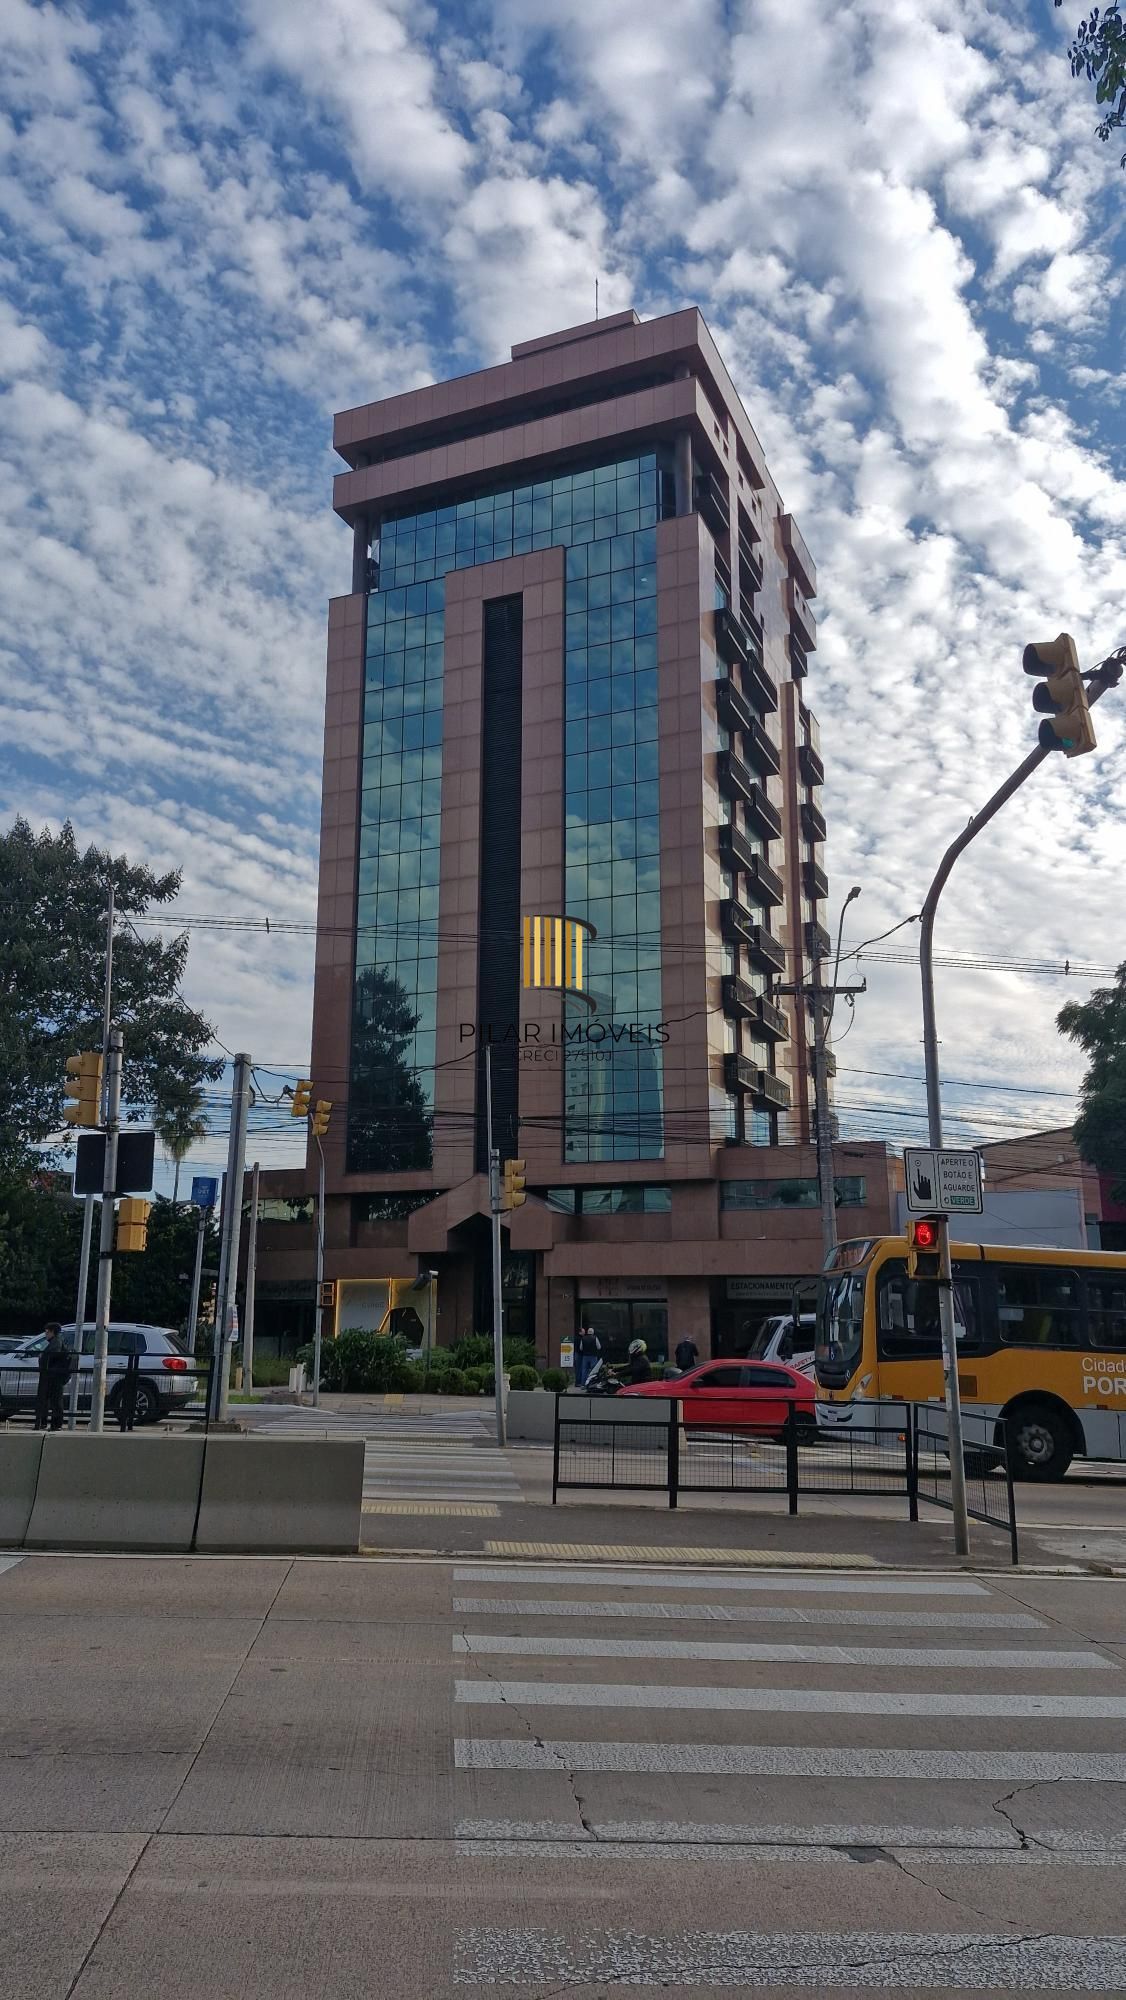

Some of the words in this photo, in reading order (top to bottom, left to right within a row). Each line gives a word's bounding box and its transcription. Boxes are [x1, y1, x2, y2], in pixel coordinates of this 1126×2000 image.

[941, 1159, 967, 1167] APERTE
[944, 1196, 950, 1204] O
[730, 1281, 794, 1291] ESTACIONAMENTO
[1082, 1357, 1126, 1373] Cidad
